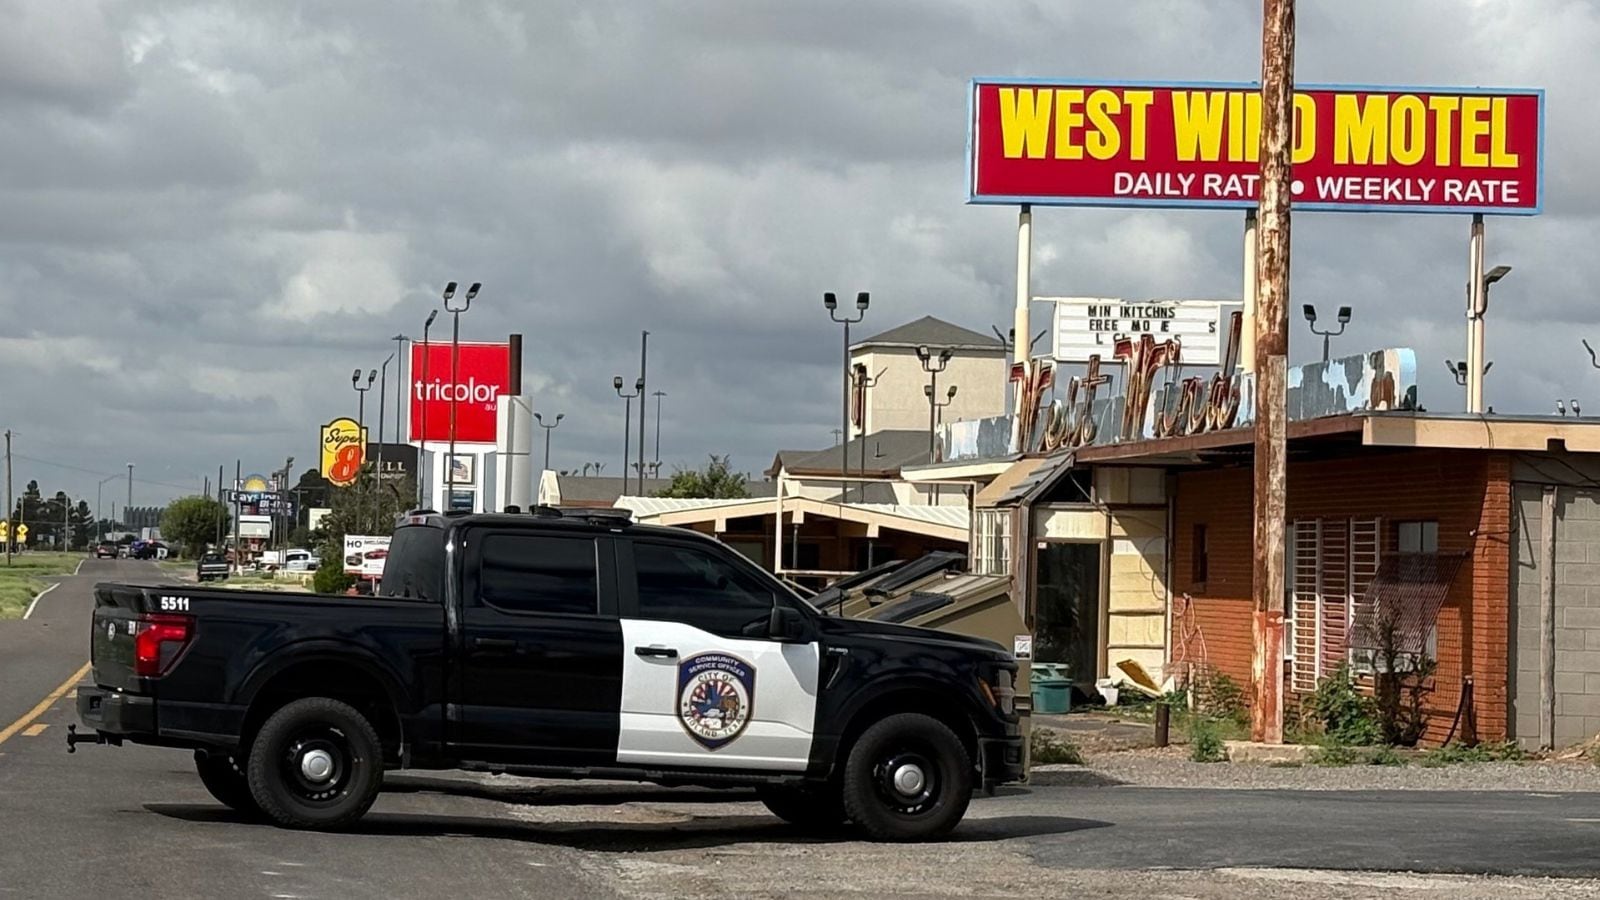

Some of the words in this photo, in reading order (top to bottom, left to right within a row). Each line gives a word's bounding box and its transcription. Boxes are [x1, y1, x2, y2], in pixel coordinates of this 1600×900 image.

[999, 88, 1153, 160] WEST
[1334, 94, 1519, 168] MOTEL
[1114, 172, 1195, 196] DAILY
[1203, 173, 1261, 198] RAT
[1316, 176, 1436, 202] WEEKLY
[1444, 179, 1520, 203] RATE
[1089, 319, 1119, 332] FREE
[415, 377, 499, 404] tricolor
[325, 428, 364, 450] Super
[329, 445, 363, 482] 8
[161, 597, 189, 611] 5511
[688, 663, 716, 674] SERVICE
[717, 663, 745, 677] OFFICER
[695, 656, 739, 667] COMMUNITY
[698, 672, 719, 682] CITY
[722, 674, 737, 682] OF
